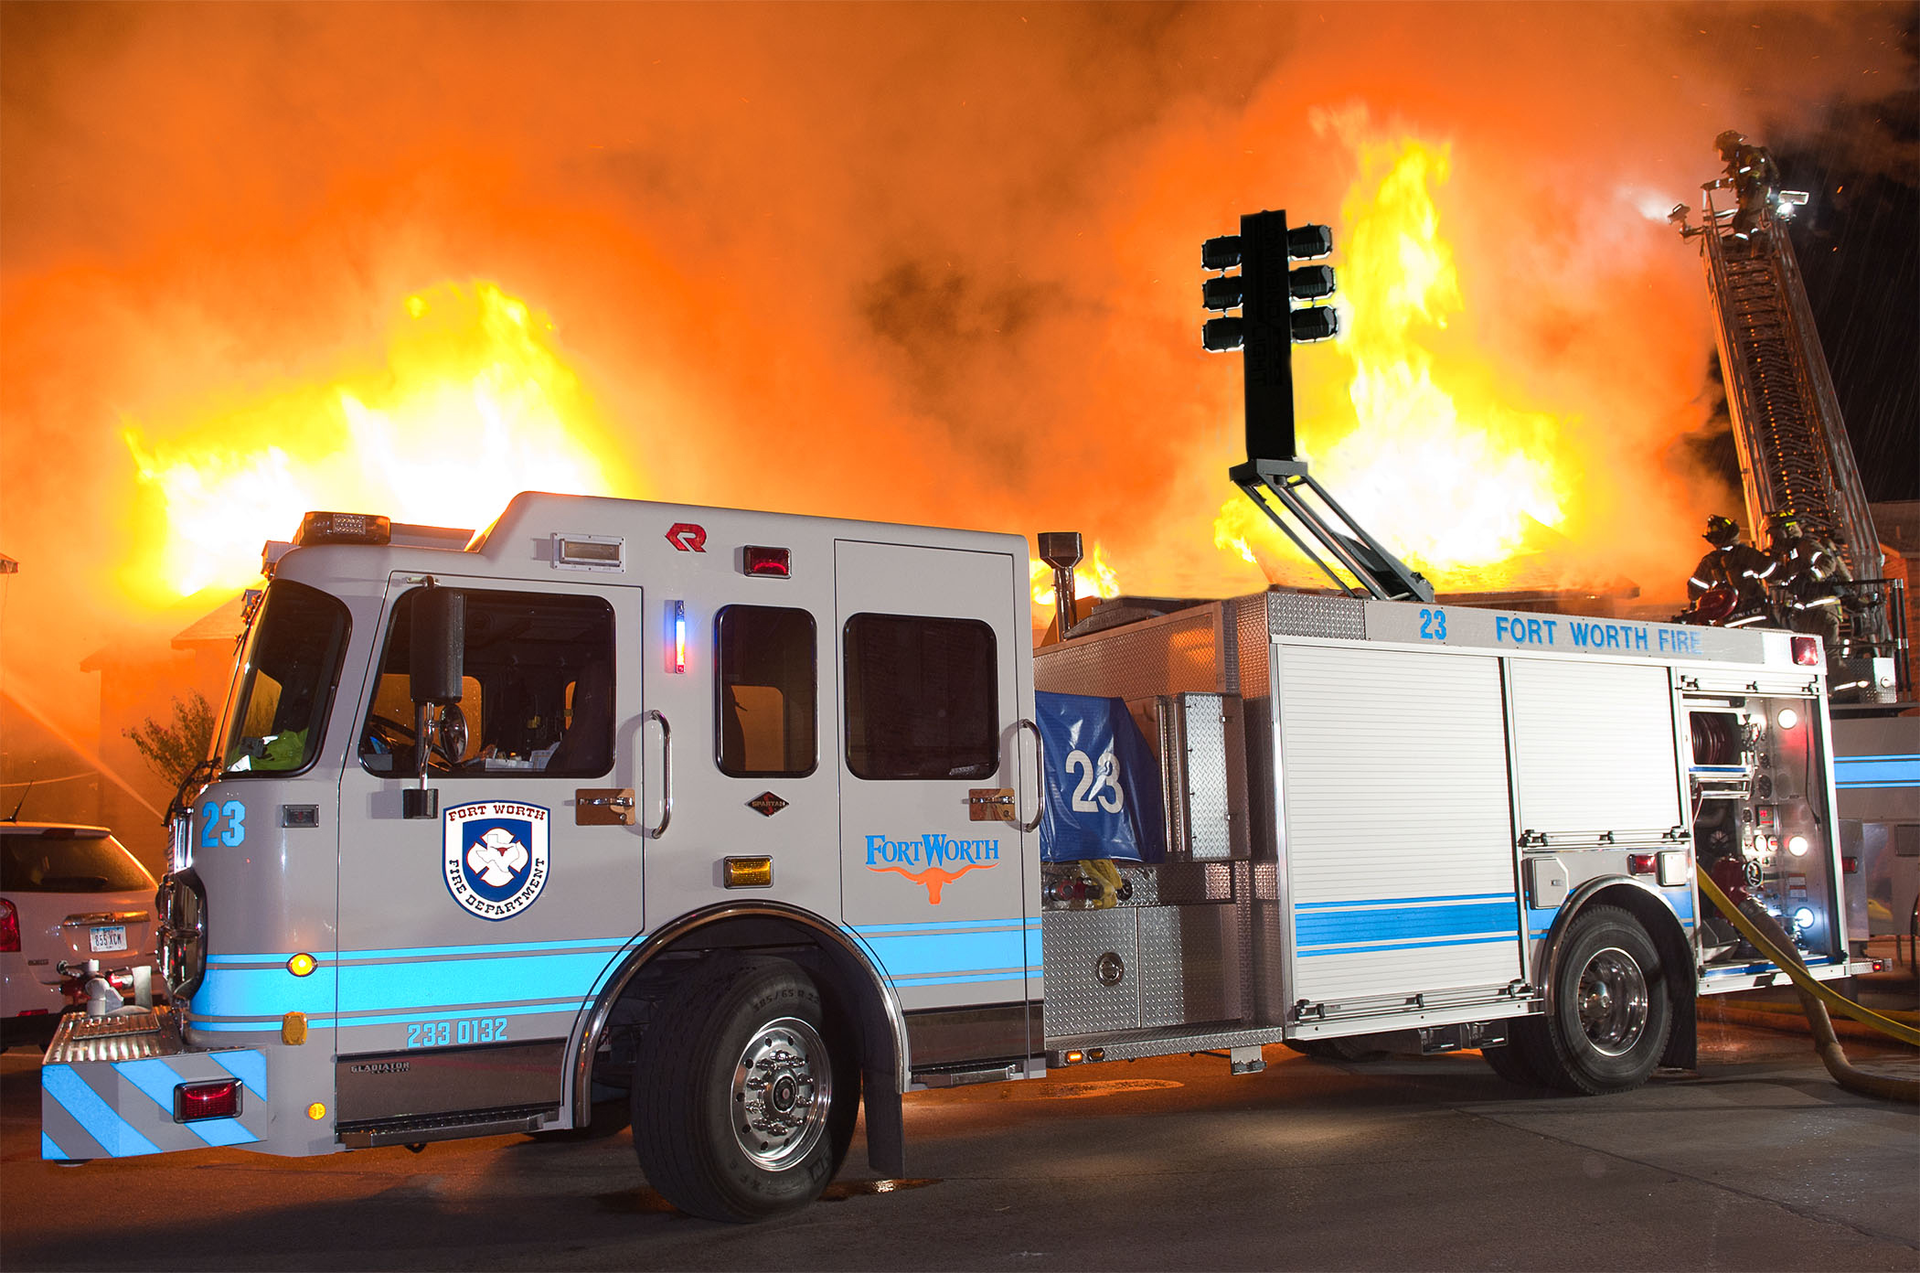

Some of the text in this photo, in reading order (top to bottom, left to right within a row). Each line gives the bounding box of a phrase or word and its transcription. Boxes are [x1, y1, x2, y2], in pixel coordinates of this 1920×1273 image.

[1419, 608, 1447, 640] 23
[1495, 616, 1704, 654] FORT WORTH FIRE
[1065, 749, 1124, 813] 23
[201, 800, 246, 848] 23
[448, 804, 546, 821] FORT WORTH
[449, 857, 545, 915] FIRE DEPARTMENT
[95, 933, 108, 946] 855
[407, 1018, 508, 1049] 233 0132
[350, 1062, 410, 1073] GLADIATOR
